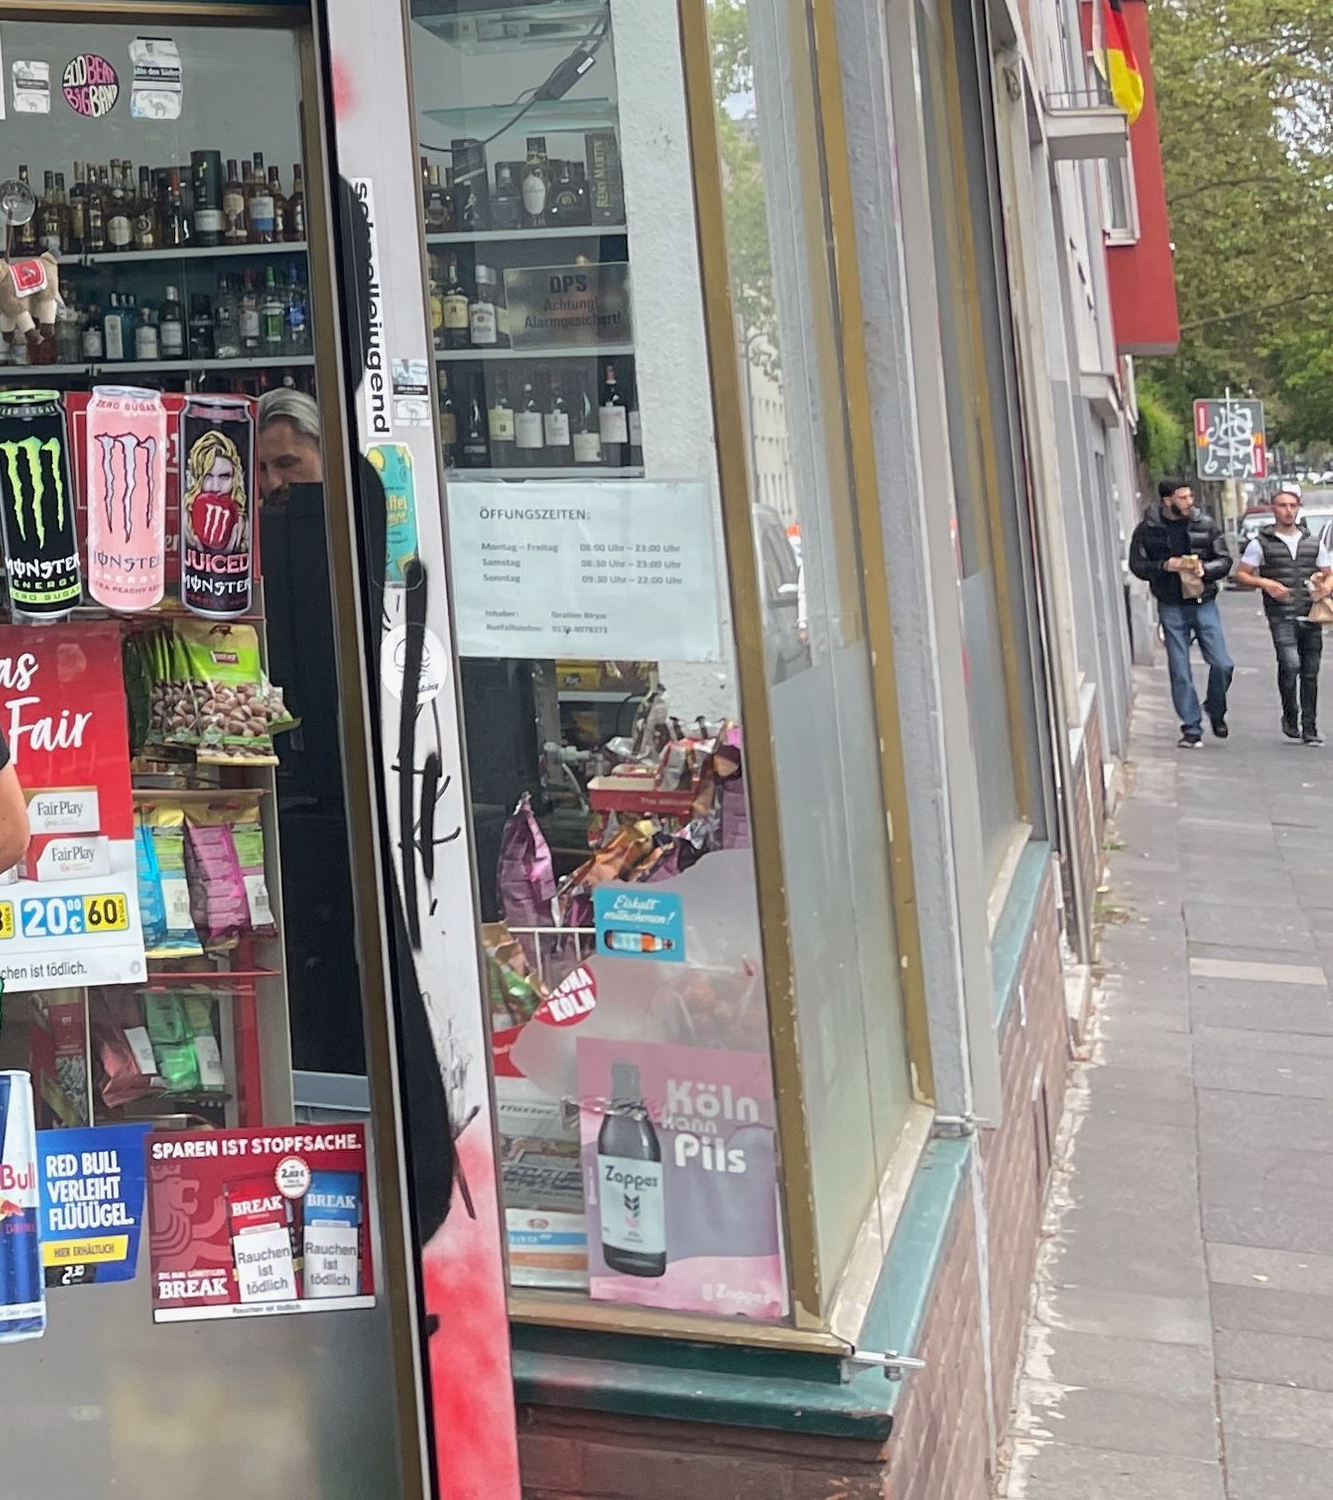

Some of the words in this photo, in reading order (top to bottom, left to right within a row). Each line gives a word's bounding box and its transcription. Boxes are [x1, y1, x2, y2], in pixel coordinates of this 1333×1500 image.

[549, 274, 587, 294] DPS
[5, 551, 81, 579] MONSTER
[184, 552, 250, 574] JUICED
[13, 576, 76, 590] ENERGY
[5, 696, 93, 765] Fair
[88, 900, 118, 926] 60
[614, 894, 661, 911] Eiskalt
[603, 911, 676, 925] mitnehmen!
[30, 965, 44, 979] ist
[47, 960, 88, 977] tödlich.
[664, 1080, 759, 1123] Köln
[661, 1112, 718, 1134] kann
[152, 1140, 219, 1160] SPAREN
[222, 1139, 249, 1156] IST
[251, 1133, 362, 1154] STOPFSACHE.
[674, 1133, 748, 1174] Pils
[45, 1154, 78, 1178] RED
[82, 1151, 121, 1175] BULL
[605, 1164, 659, 1190] Zappes
[46, 1176, 121, 1203] VERLEIHT
[231, 1195, 283, 1216] BREAK
[307, 1193, 357, 1209] BREAK
[49, 1201, 135, 1231] FLÜÜÜGEL.
[238, 1246, 291, 1263] Rauchen
[306, 1242, 357, 1256] Rauchen
[258, 1264, 273, 1277] ist
[323, 1257, 338, 1270] ist
[159, 1277, 228, 1299] BREAK
[247, 1277, 289, 1295] tödlich
[310, 1271, 351, 1285] tödlich
